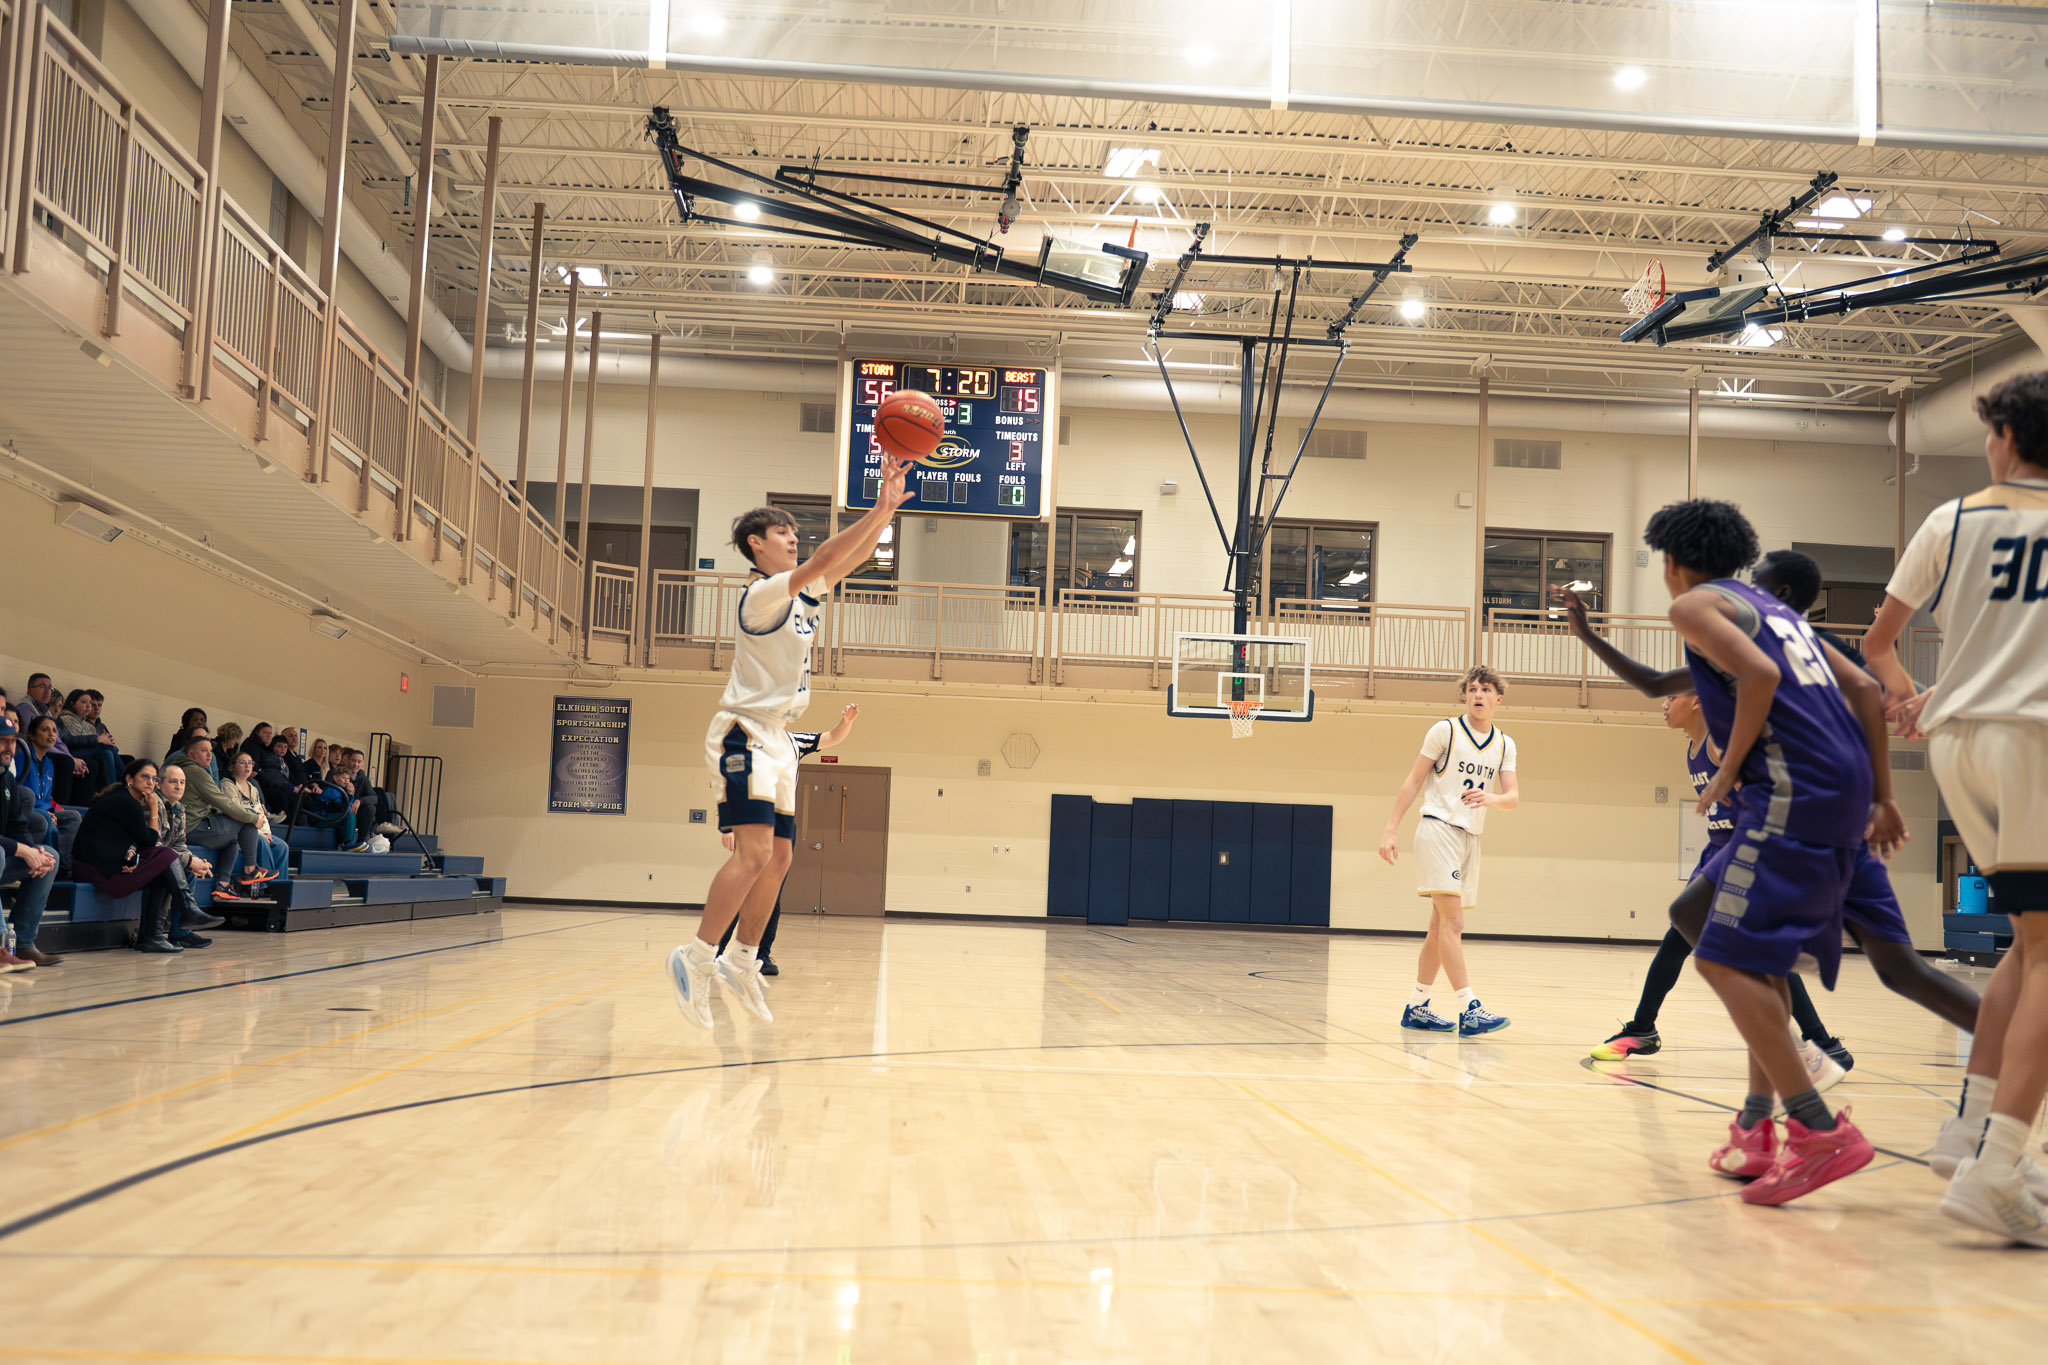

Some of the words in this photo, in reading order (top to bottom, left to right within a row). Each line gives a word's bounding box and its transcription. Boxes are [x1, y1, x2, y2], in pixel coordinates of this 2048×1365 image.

[862, 363, 894, 376] STORM
[927, 368, 989, 395] 7:20
[1005, 371, 1036, 384] BEAST
[1017, 388, 1039, 412] 15
[941, 407, 955, 416] IOD
[960, 404, 971, 424] 3
[995, 415, 1024, 426] BONUS
[856, 423, 876, 433] TIME
[996, 431, 1039, 443] TIMEOUTS
[942, 447, 981, 458] STORM
[1011, 441, 1023, 461] 3
[1005, 461, 1027, 472] LEFT
[864, 467, 884, 478] FOU
[916, 470, 948, 481] PLAYER
[954, 472, 981, 483] FOULS
[999, 474, 1026, 485] FOULS
[1012, 486, 1025, 505] 0
[1491, 597, 1512, 605] STORM
[556, 703, 597, 713] ELKHORN
[599, 705, 629, 714] SOUTH
[556, 719, 627, 729] SPORTSMANSHIP
[561, 734, 619, 744] EXPECTATION
[1458, 761, 1494, 780] SOUTH
[551, 800, 580, 808] STORM
[597, 802, 622, 810] PRIDE
